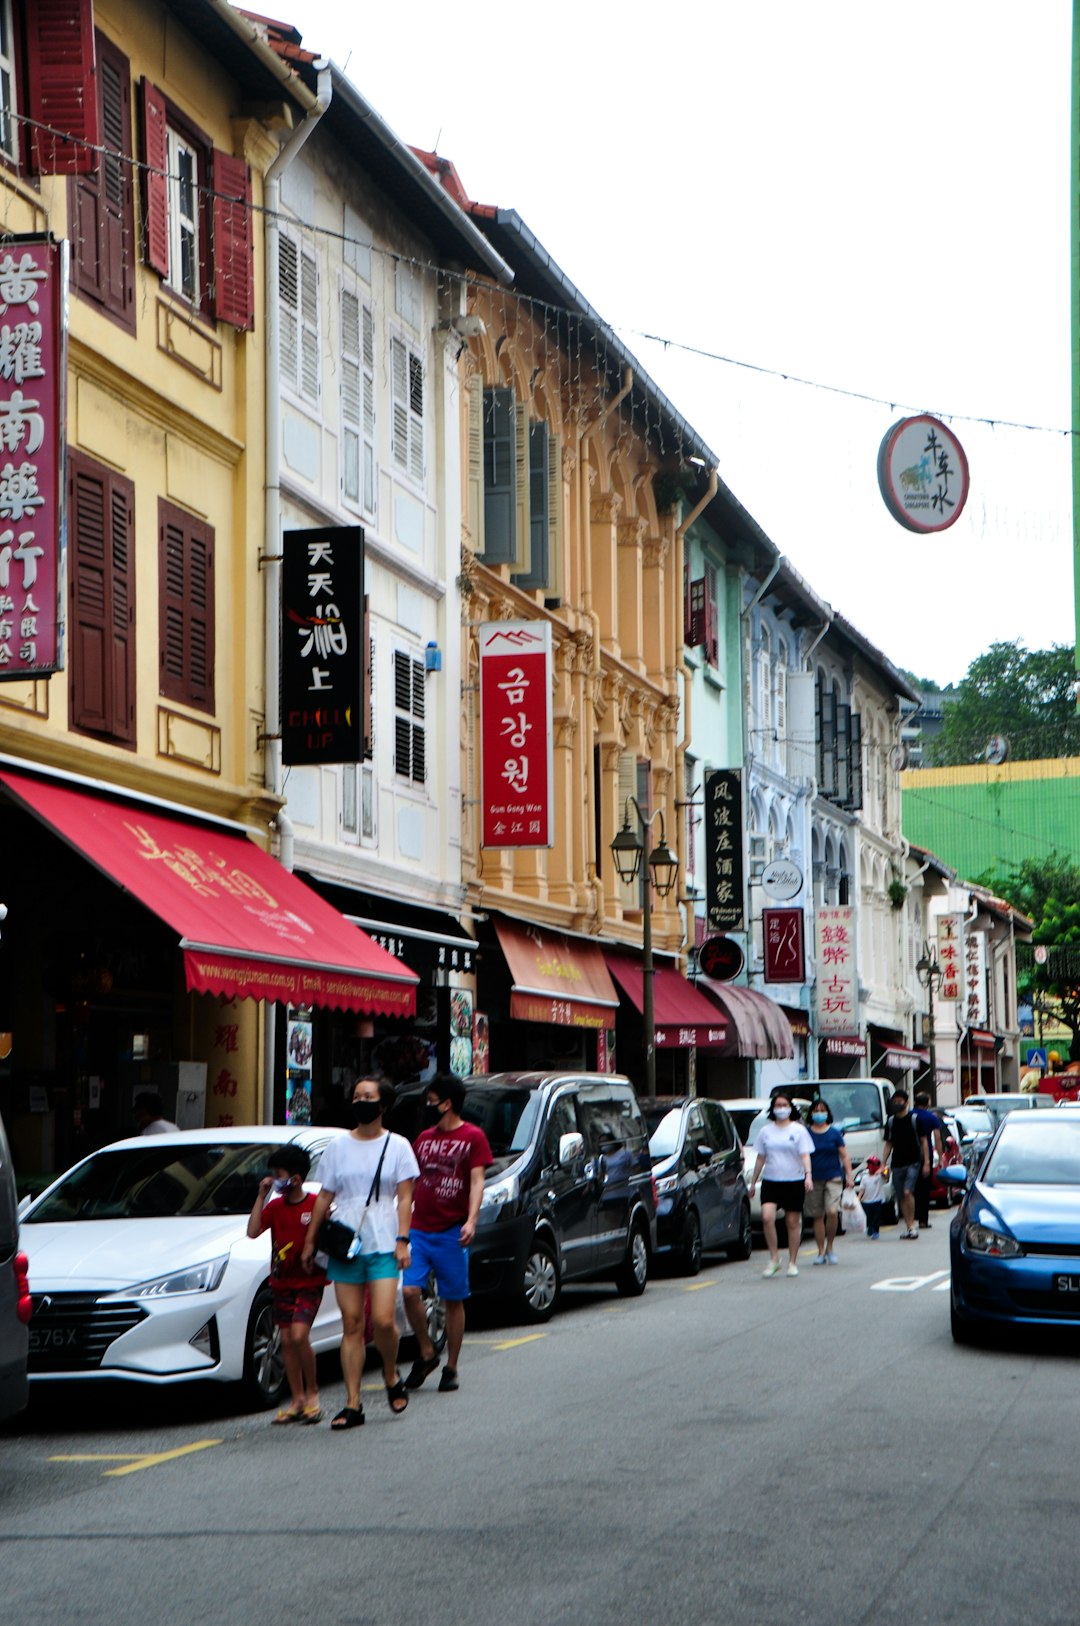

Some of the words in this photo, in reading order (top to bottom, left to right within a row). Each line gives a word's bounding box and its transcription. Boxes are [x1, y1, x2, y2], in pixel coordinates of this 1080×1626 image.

[298, 541, 348, 691] 天天湘上
[497, 667, 533, 793] 금강원
[713, 780, 735, 904] 风波庄酒家
[716, 914, 737, 922] Food
